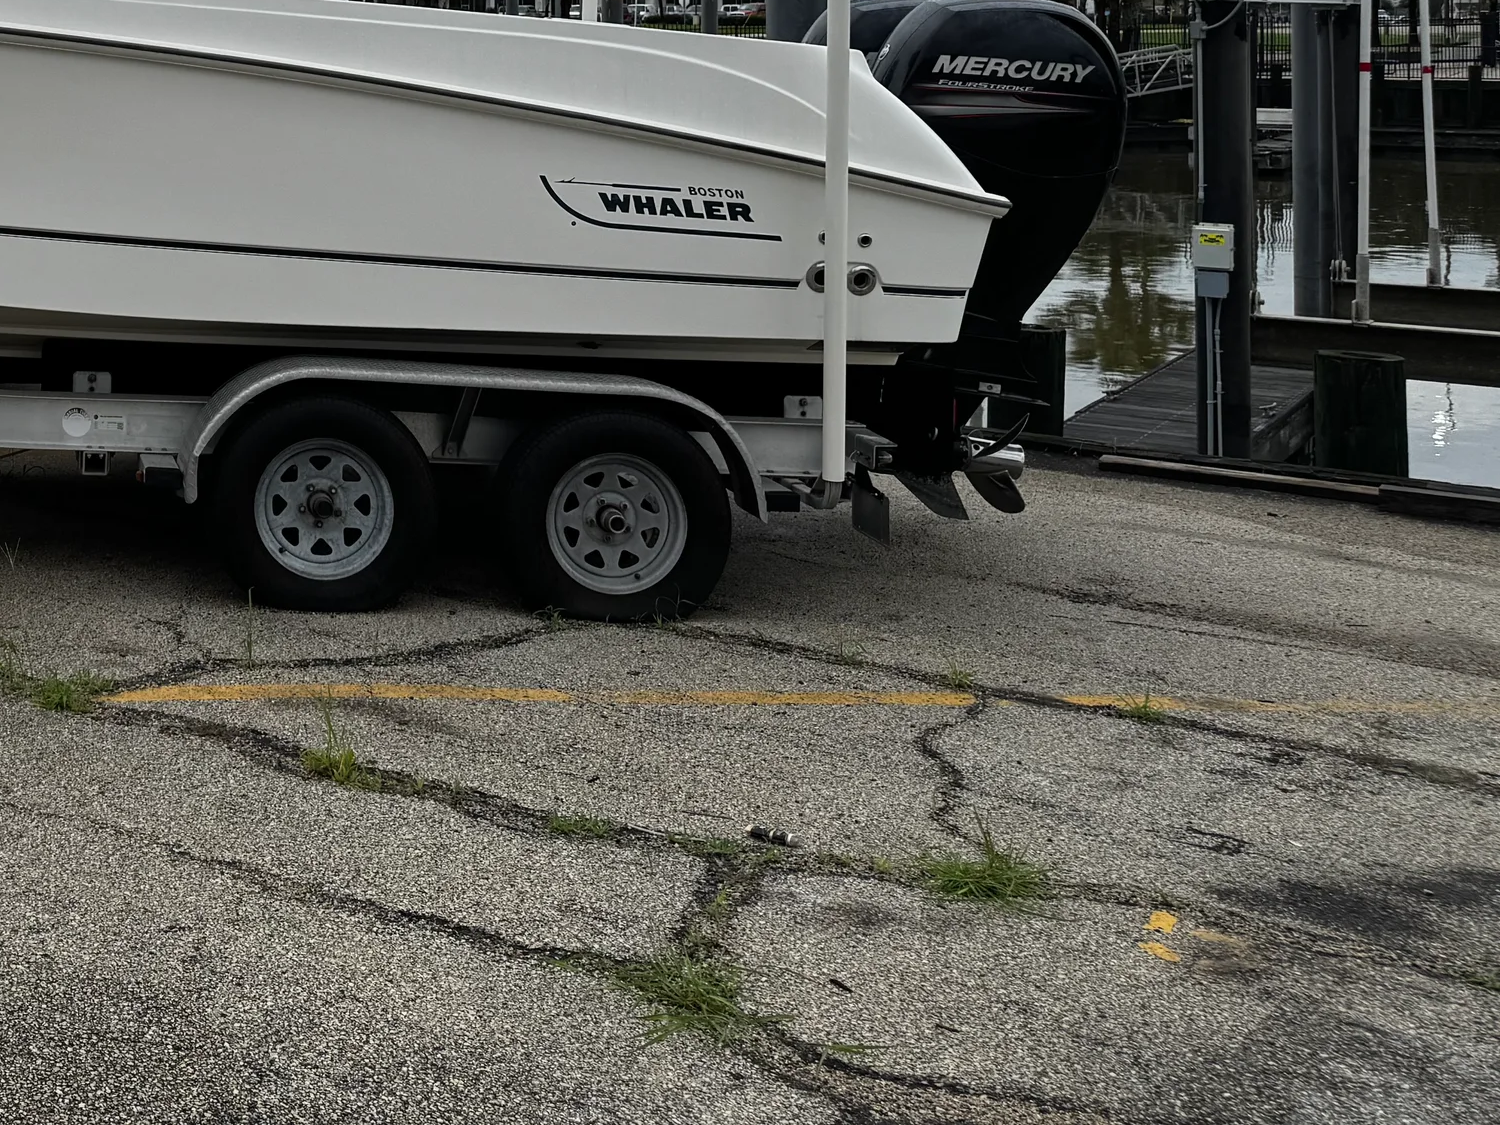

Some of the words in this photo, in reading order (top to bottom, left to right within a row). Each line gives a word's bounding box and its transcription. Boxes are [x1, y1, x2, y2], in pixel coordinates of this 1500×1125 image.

[932, 55, 1096, 84] MERCURY
[938, 79, 1035, 93] FOURSTROKE
[688, 186, 745, 200] BOSTON
[598, 192, 755, 223] WHALER
